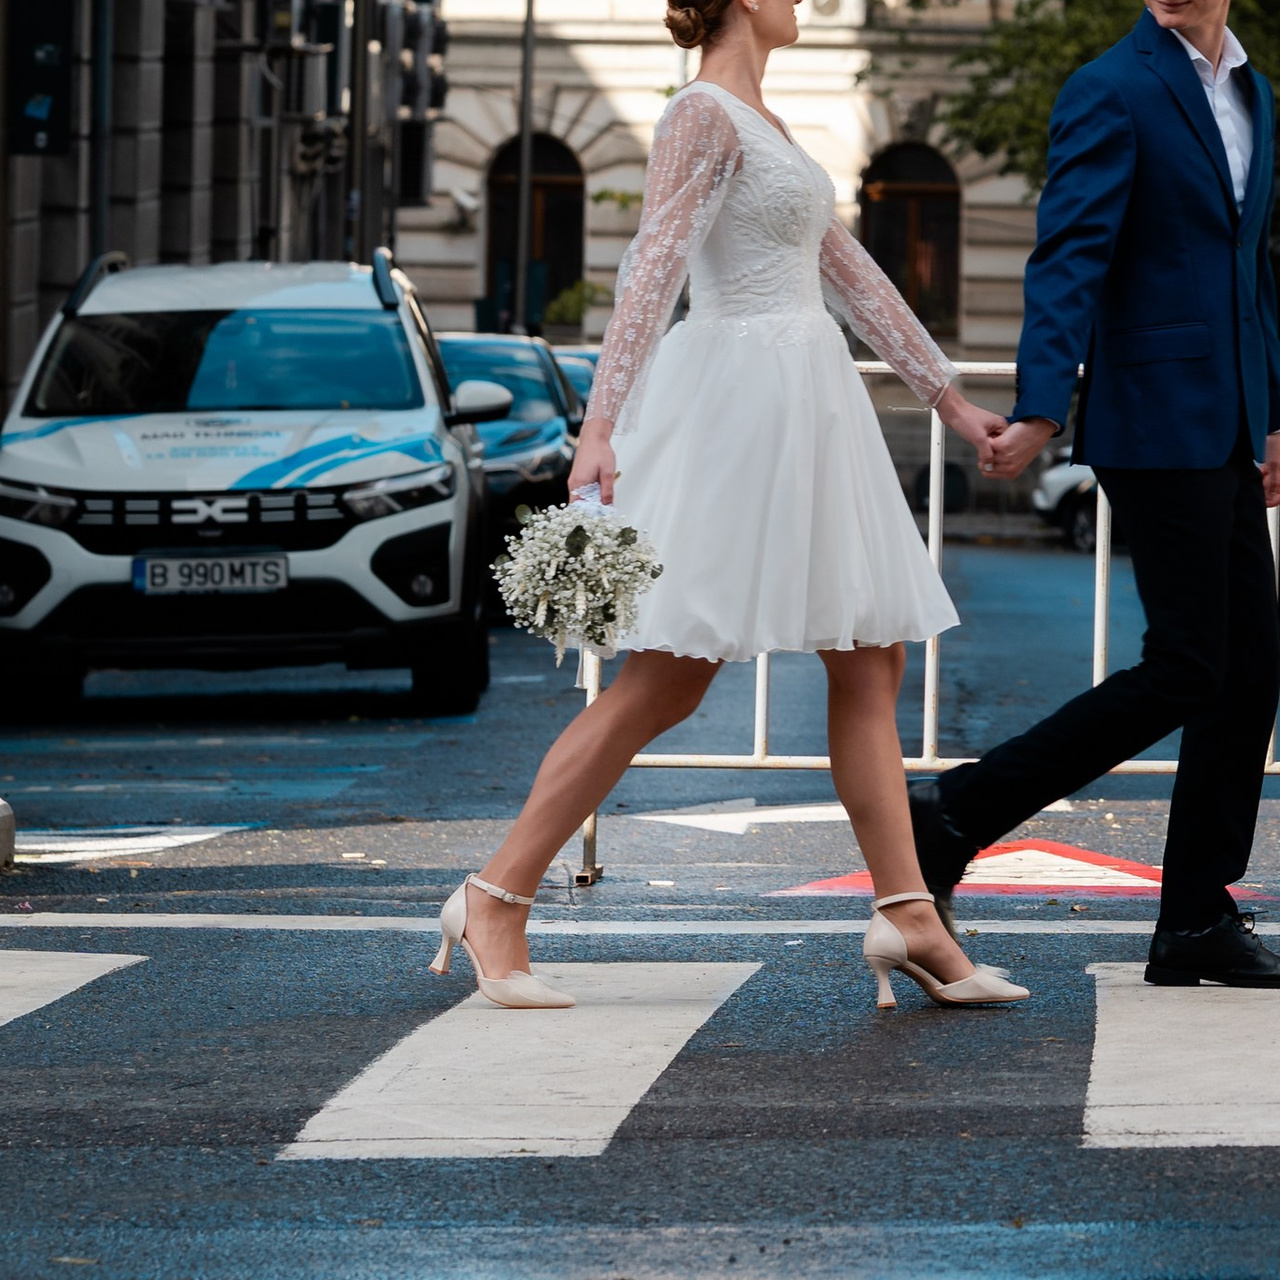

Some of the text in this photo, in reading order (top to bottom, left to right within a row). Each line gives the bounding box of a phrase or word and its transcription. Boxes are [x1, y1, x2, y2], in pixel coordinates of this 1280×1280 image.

[150, 561, 281, 587] B 990 MTS
